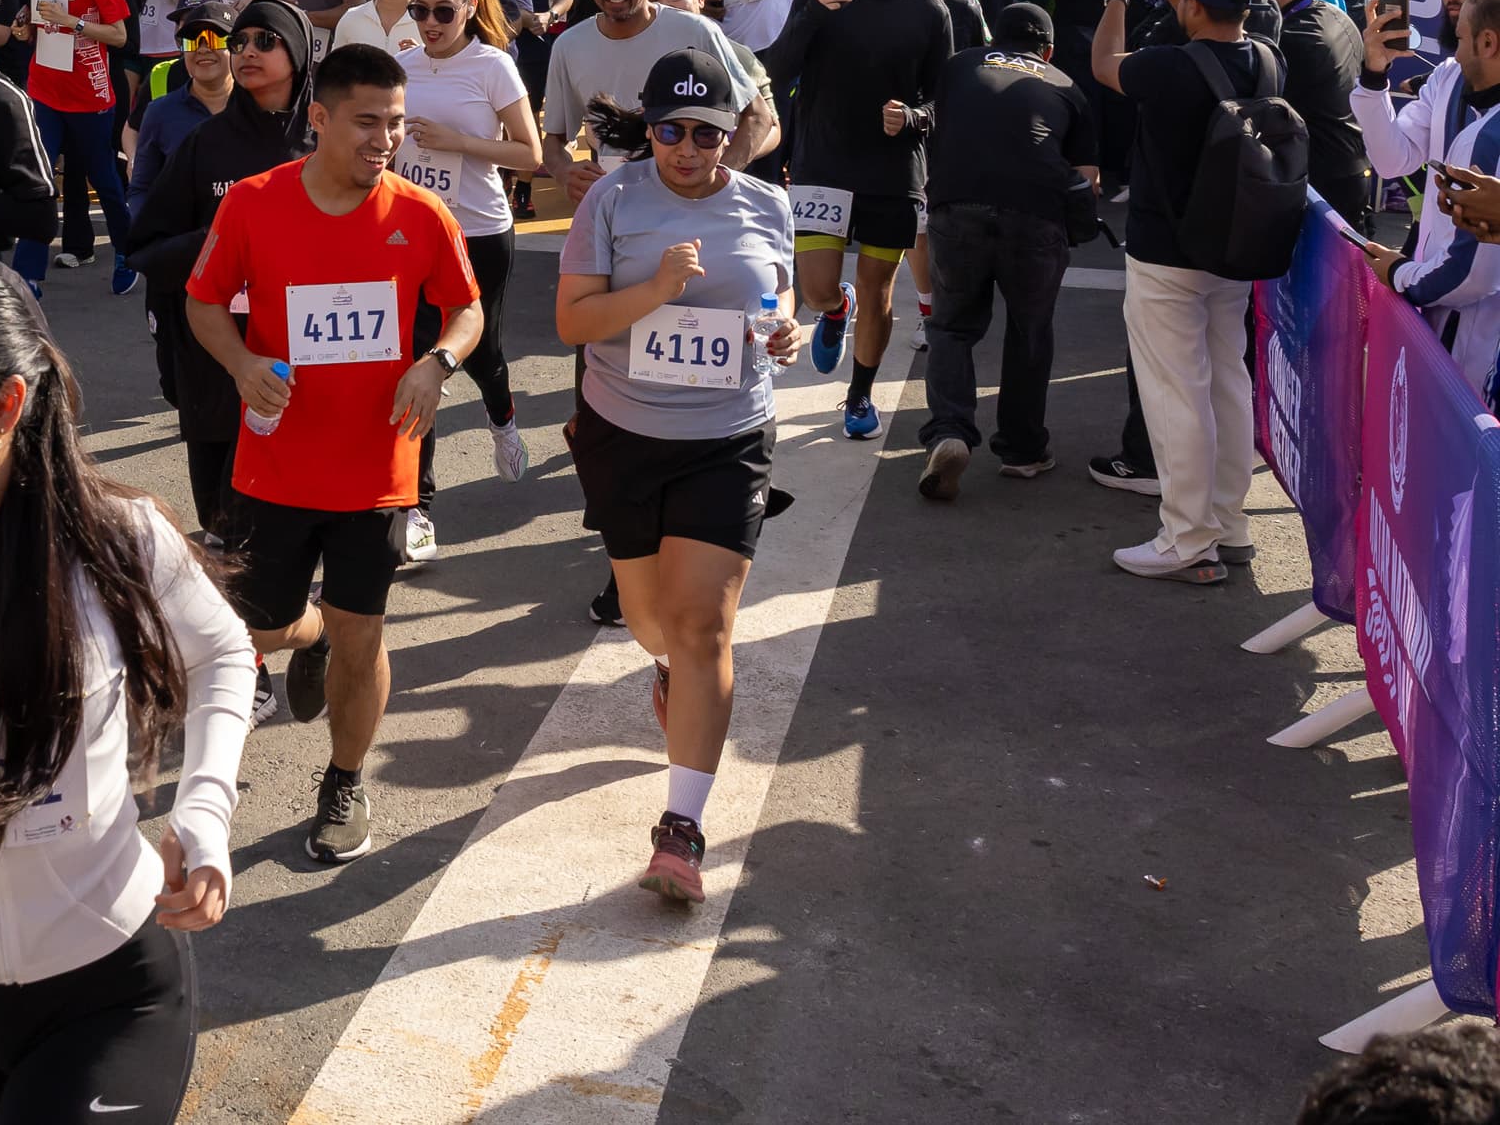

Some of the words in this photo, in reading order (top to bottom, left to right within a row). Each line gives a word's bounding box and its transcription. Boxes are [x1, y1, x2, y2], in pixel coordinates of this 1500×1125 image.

[673, 74, 708, 98] alo
[401, 162, 451, 191] 4055
[792, 202, 842, 223] 4223
[303, 310, 385, 342] 4117
[645, 330, 730, 367] 4119
